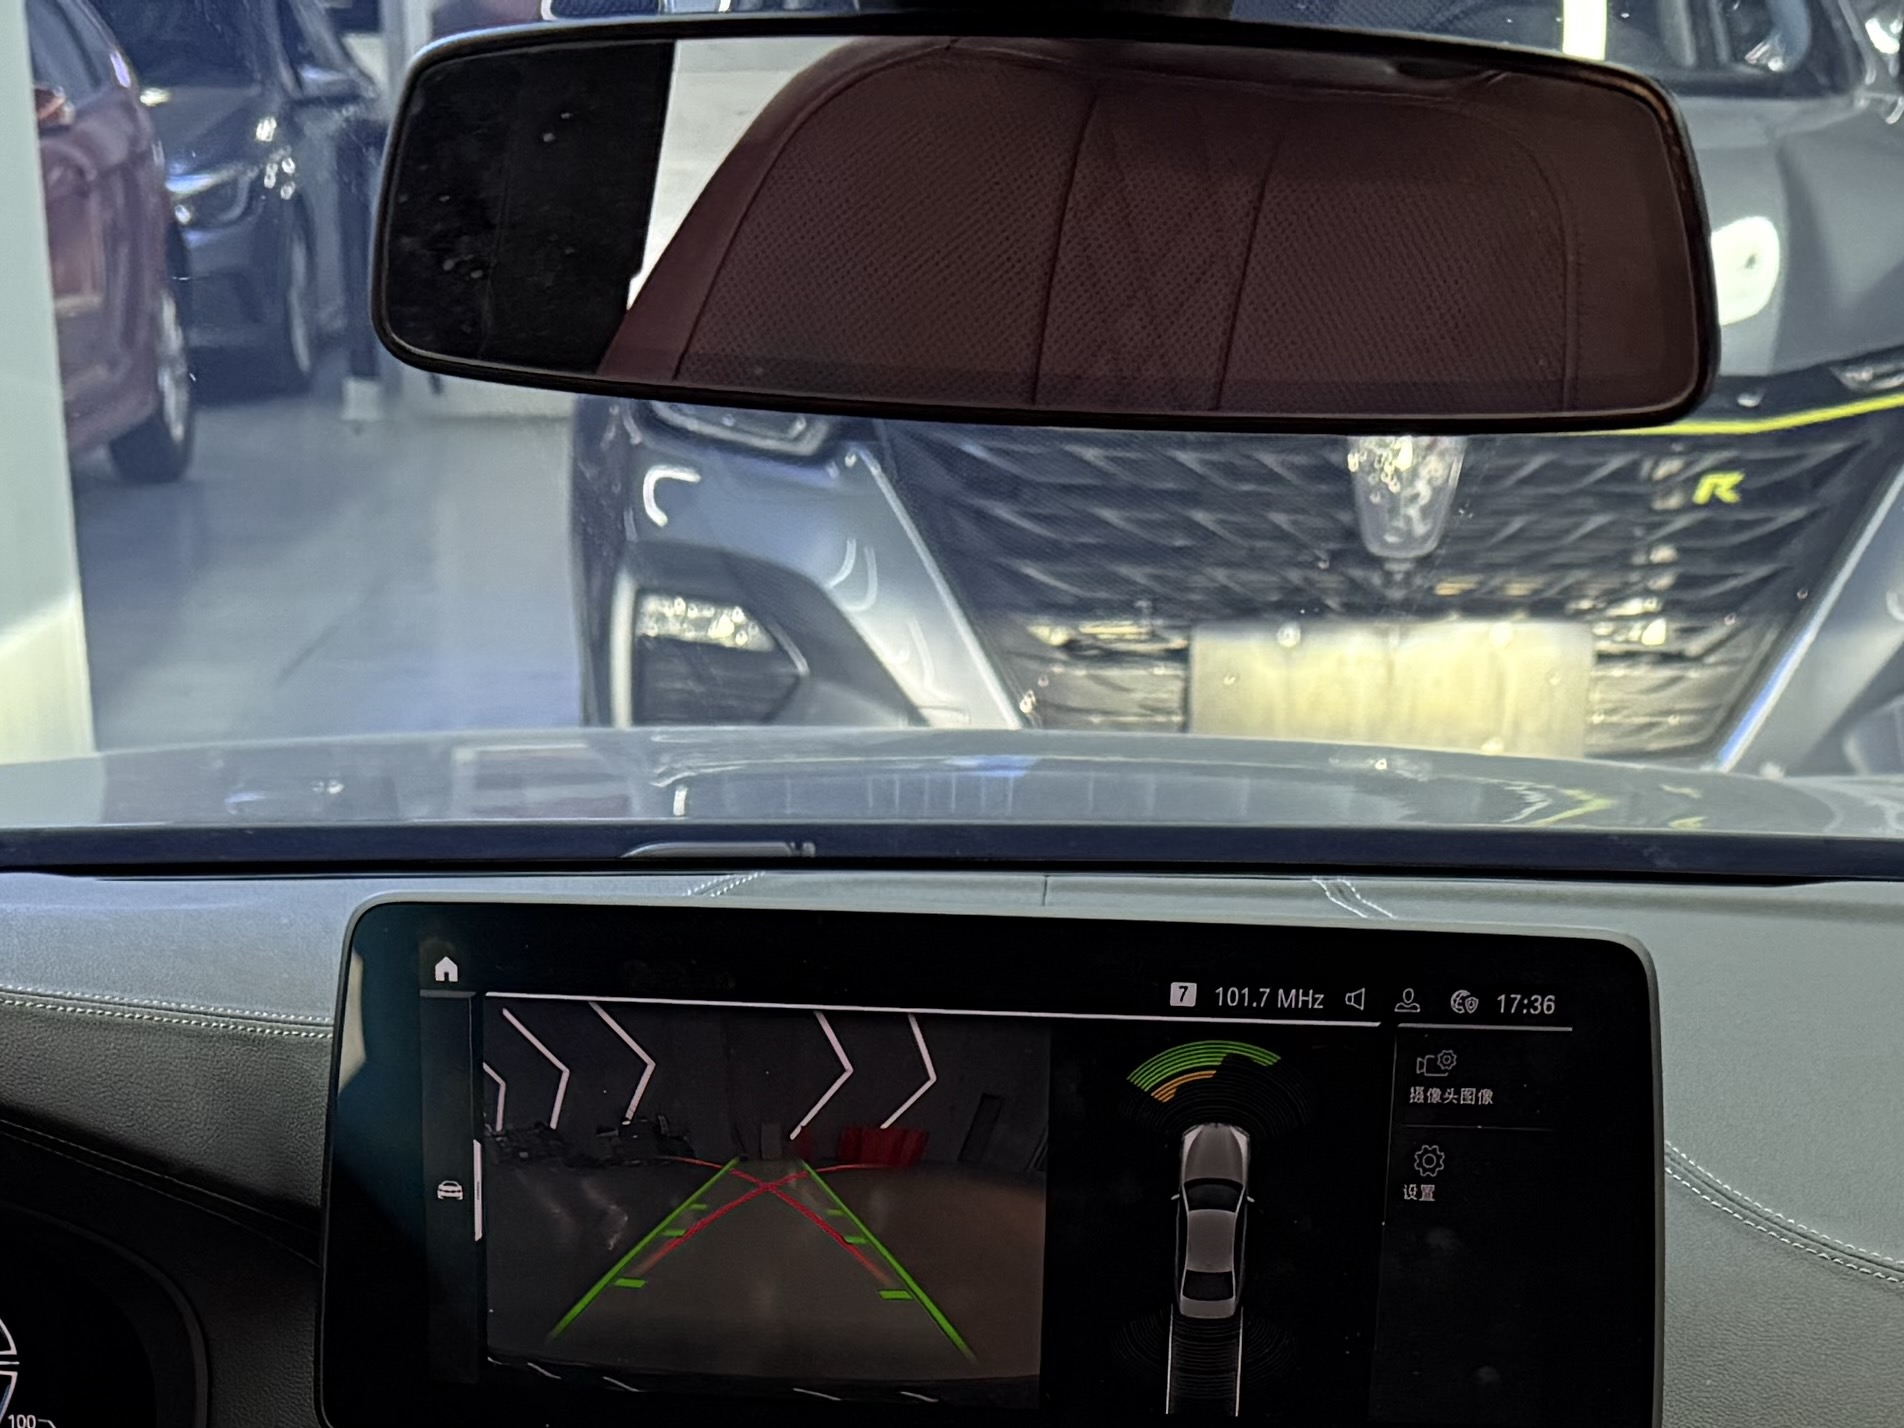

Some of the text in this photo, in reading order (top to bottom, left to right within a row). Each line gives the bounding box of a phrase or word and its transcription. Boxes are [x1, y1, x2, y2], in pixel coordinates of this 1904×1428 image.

[1178, 985, 1189, 1003] 7
[1215, 987, 1325, 1010] 101.7 MHz
[1497, 994, 1556, 1015] 17:36
[1409, 1086, 1494, 1105] 摄像头图像
[1402, 1184, 1436, 1202] 设置
